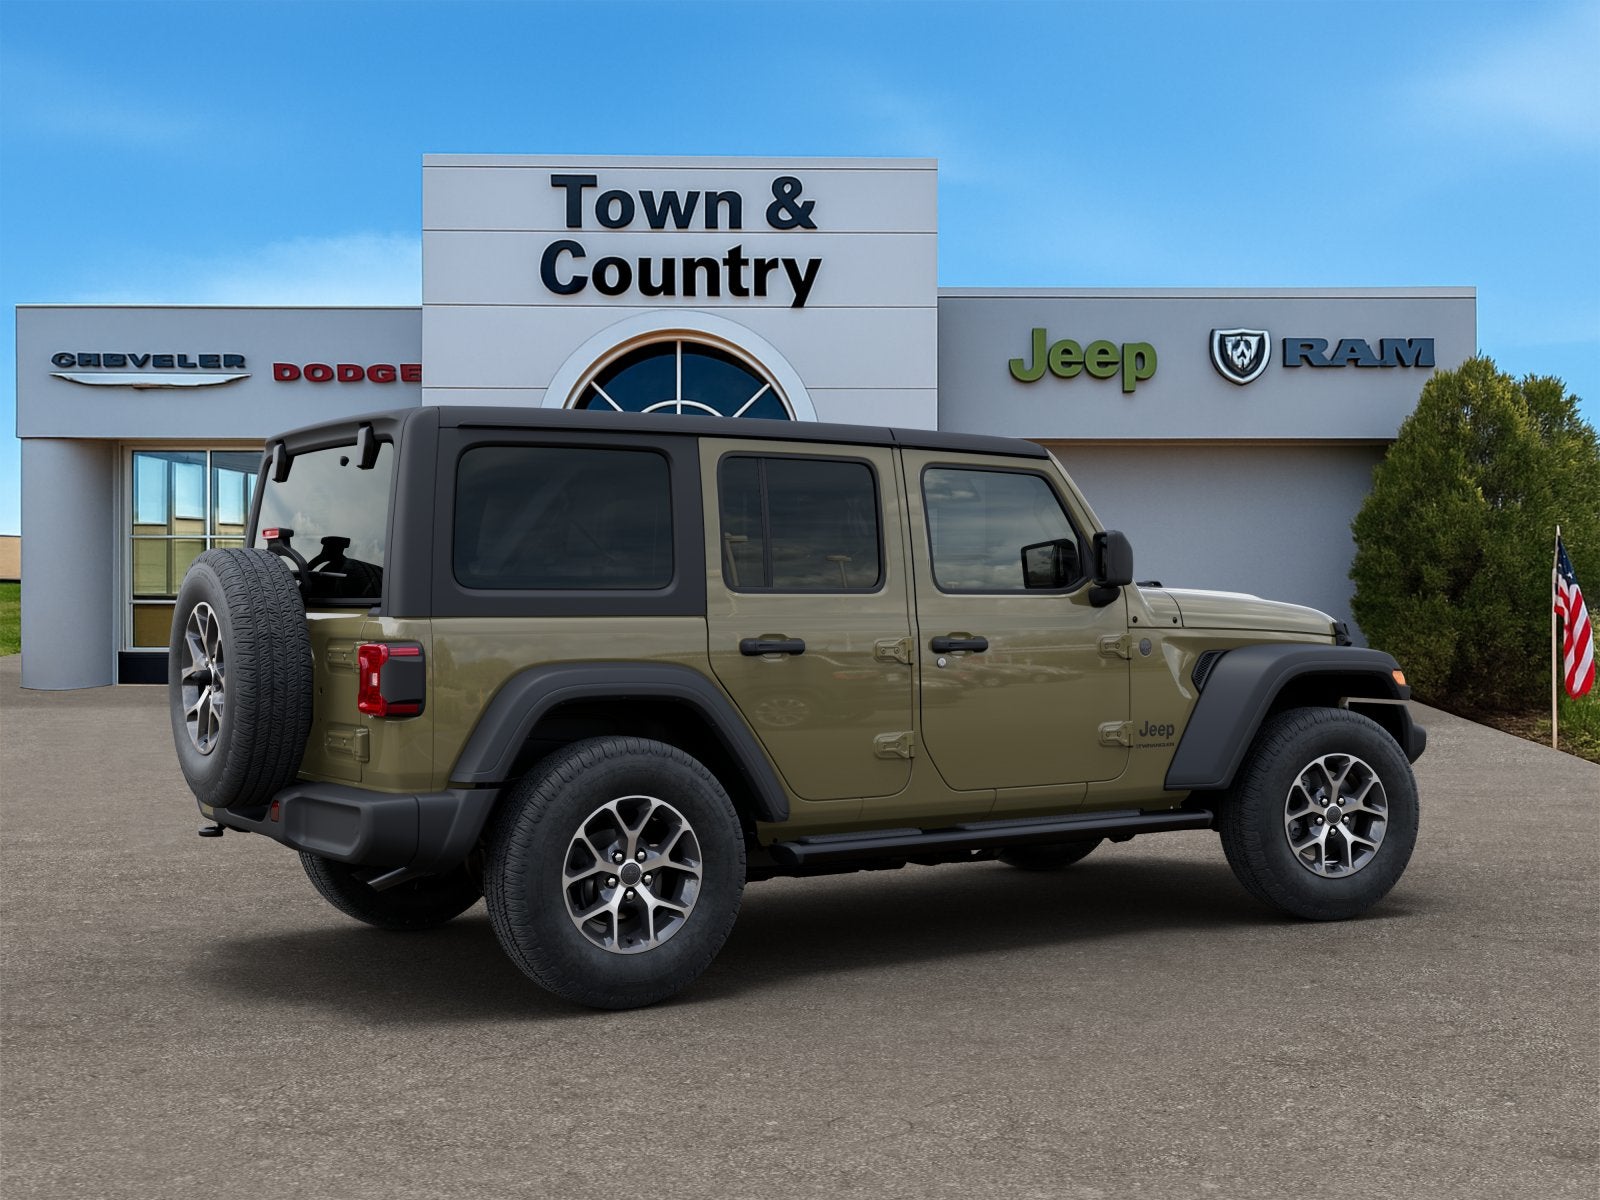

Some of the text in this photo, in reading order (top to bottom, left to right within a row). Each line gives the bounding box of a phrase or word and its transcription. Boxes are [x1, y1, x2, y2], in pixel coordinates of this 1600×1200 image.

[550, 174, 818, 230] Town &
[540, 239, 822, 308] Country
[272, 362, 422, 383] DODGE
[1009, 328, 1157, 392] Jeep
[1282, 337, 1435, 368] RAM
[1139, 720, 1175, 739] Jeep
